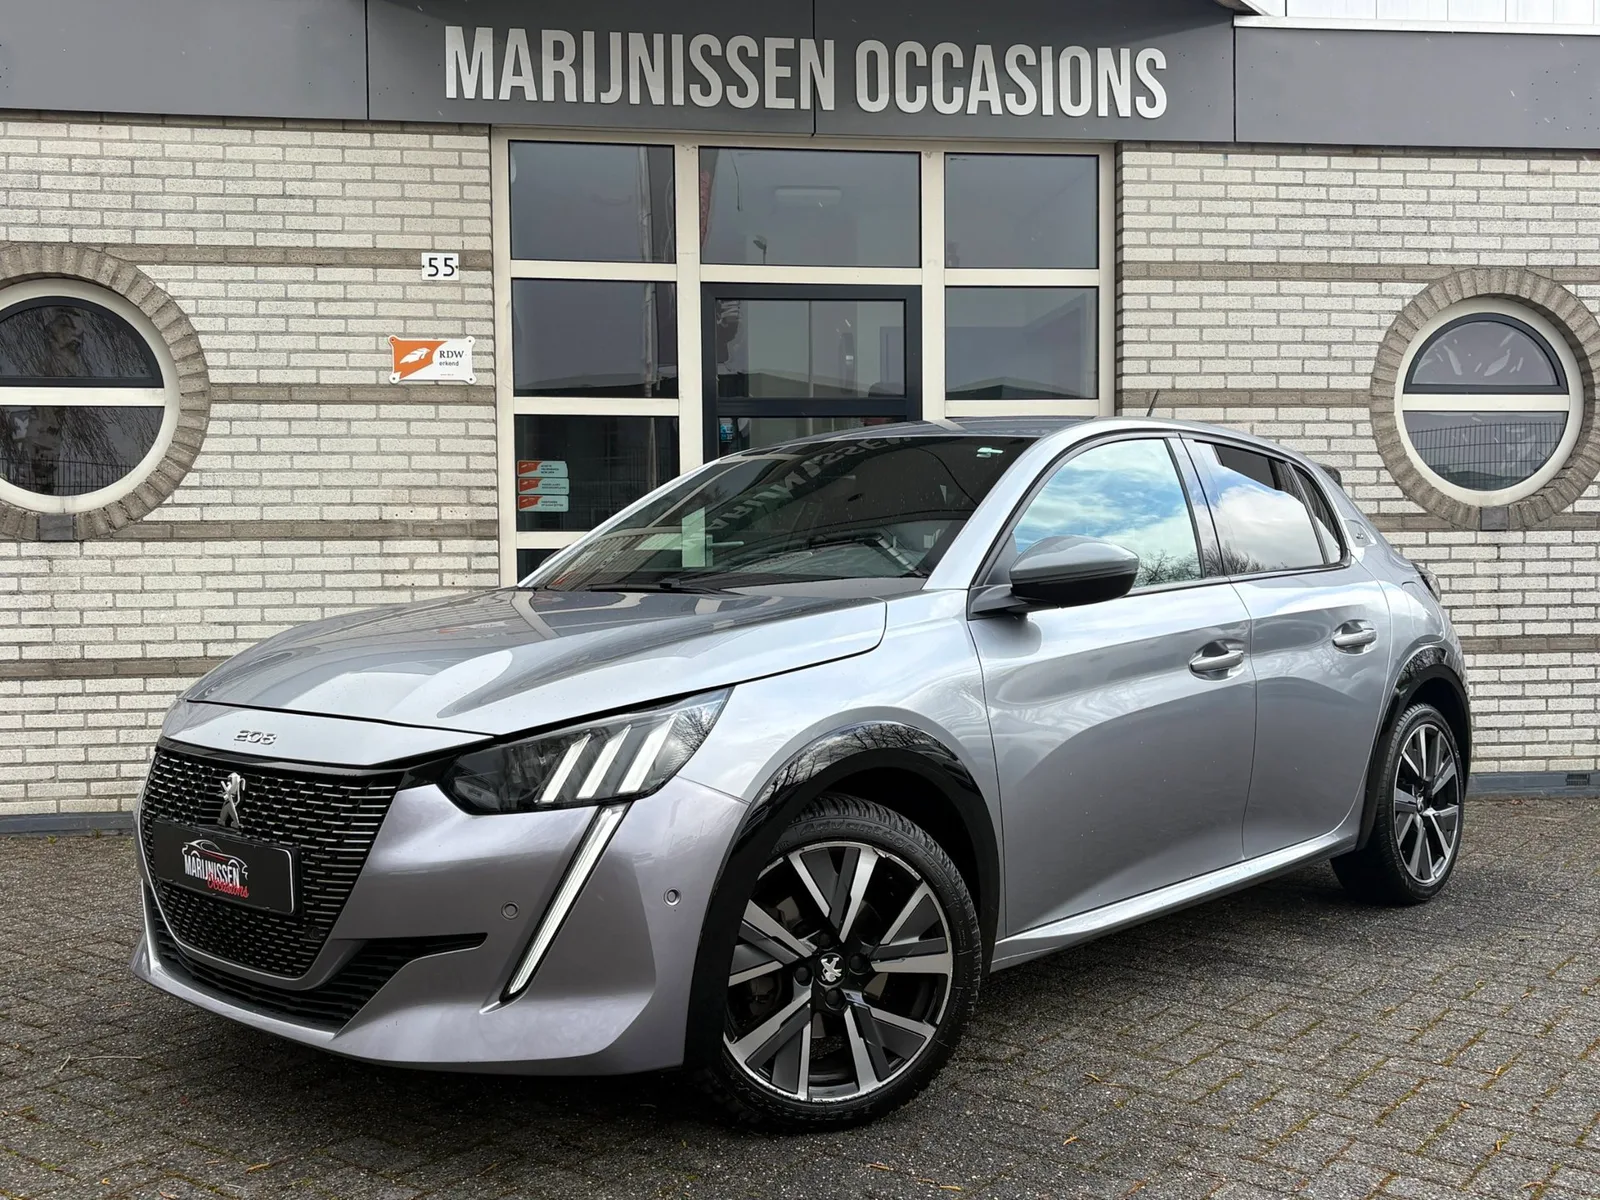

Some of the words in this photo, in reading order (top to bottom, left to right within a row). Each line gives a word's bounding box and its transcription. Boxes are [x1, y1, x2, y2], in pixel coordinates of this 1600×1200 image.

[444, 26, 835, 111] MARIJNISSEN
[855, 40, 1168, 119] OCCASIONS
[428, 257, 455, 277] 55
[439, 350, 465, 359] RDW
[233, 730, 277, 745] 208
[184, 854, 240, 888] MARIJNISSEN
